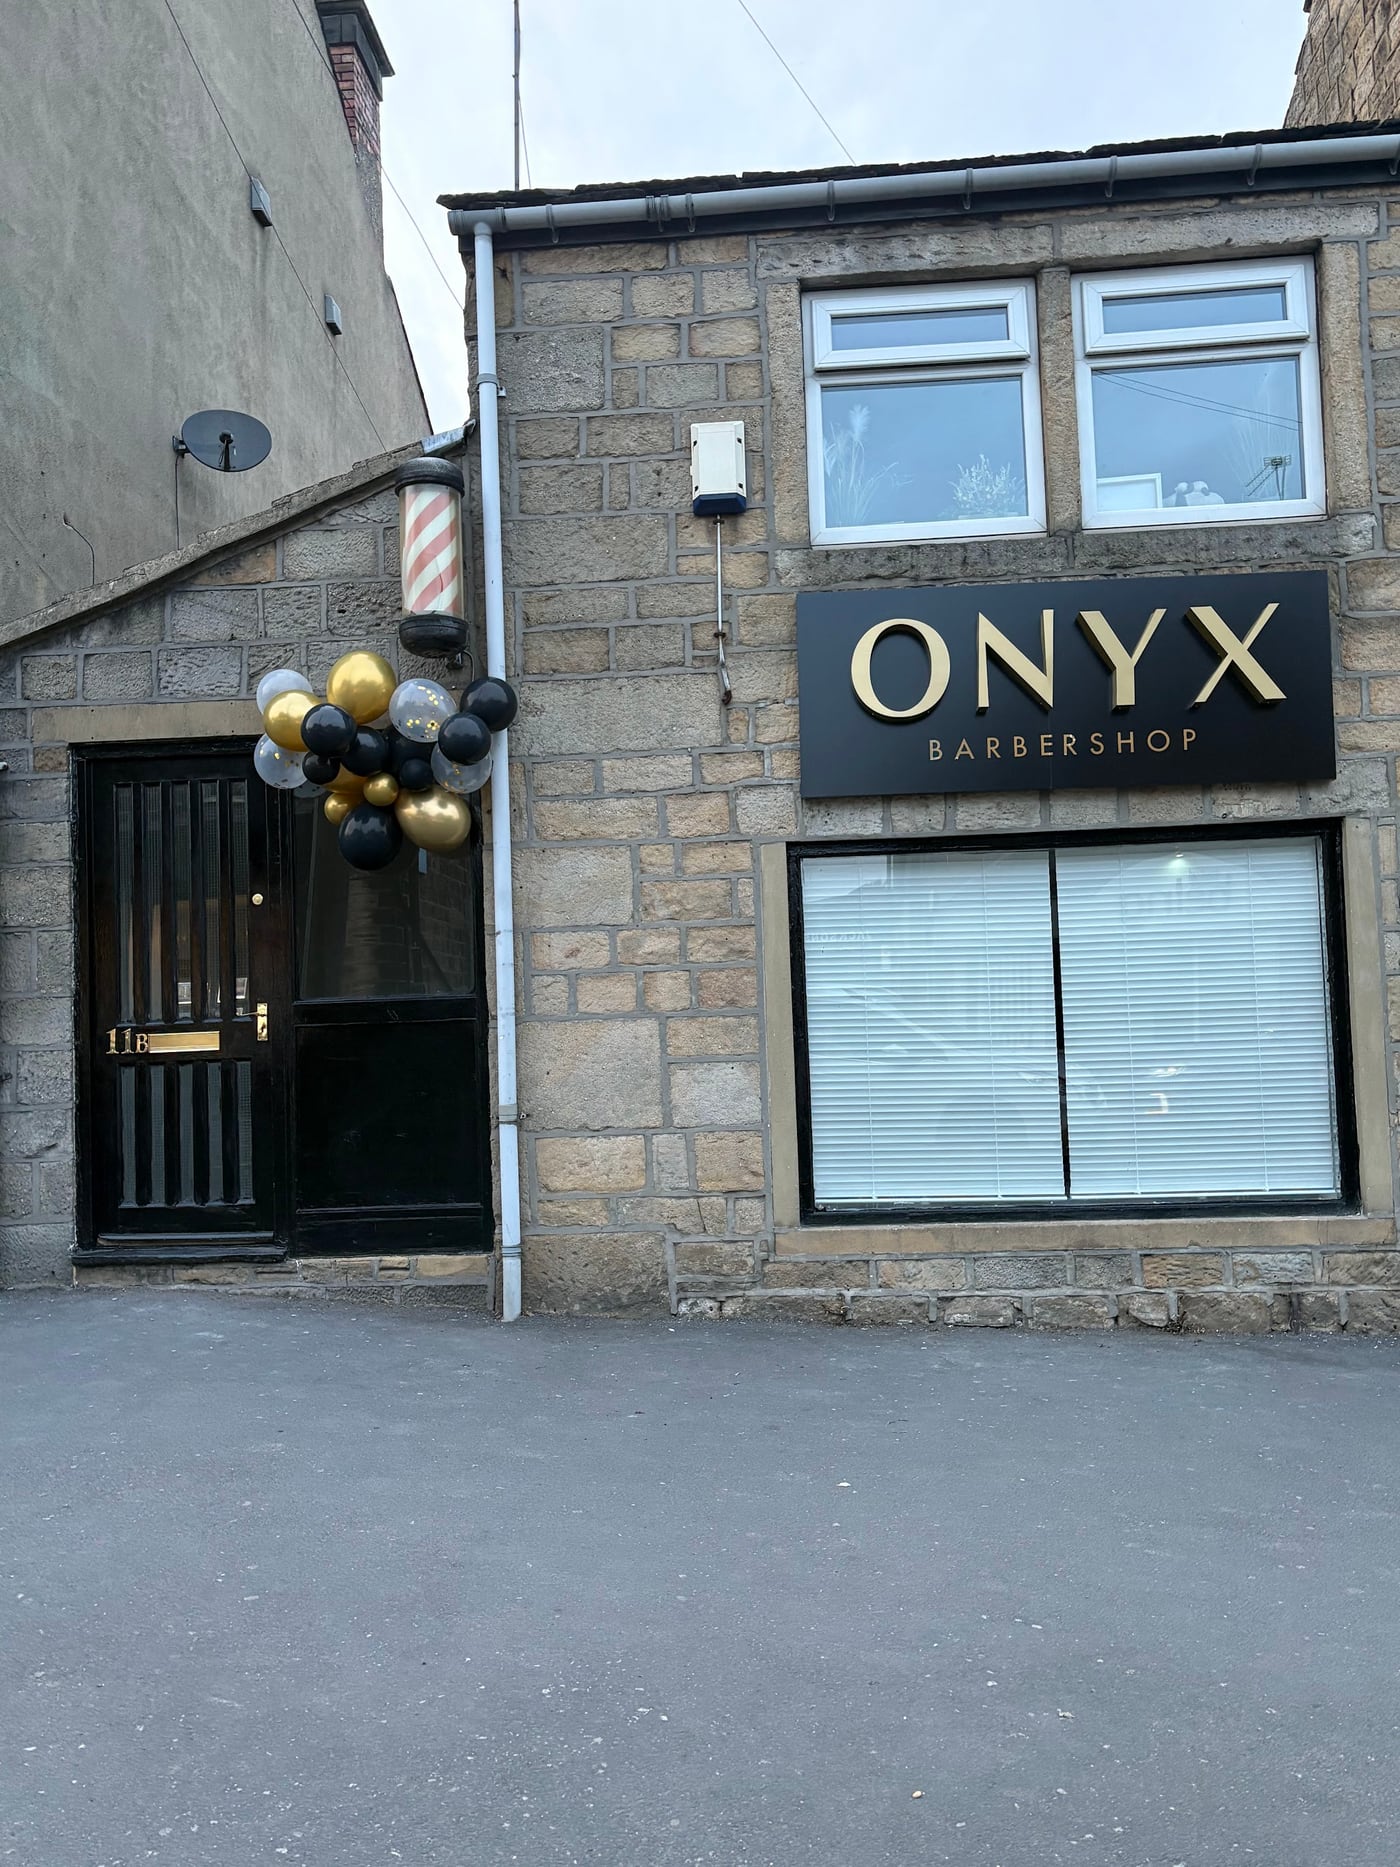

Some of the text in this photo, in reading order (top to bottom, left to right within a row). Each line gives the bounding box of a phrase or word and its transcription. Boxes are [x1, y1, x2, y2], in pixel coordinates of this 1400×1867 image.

[851, 603, 1287, 719] ONYX
[928, 728, 1197, 761] BARBERSHOP
[105, 1028, 150, 1055] 11B
